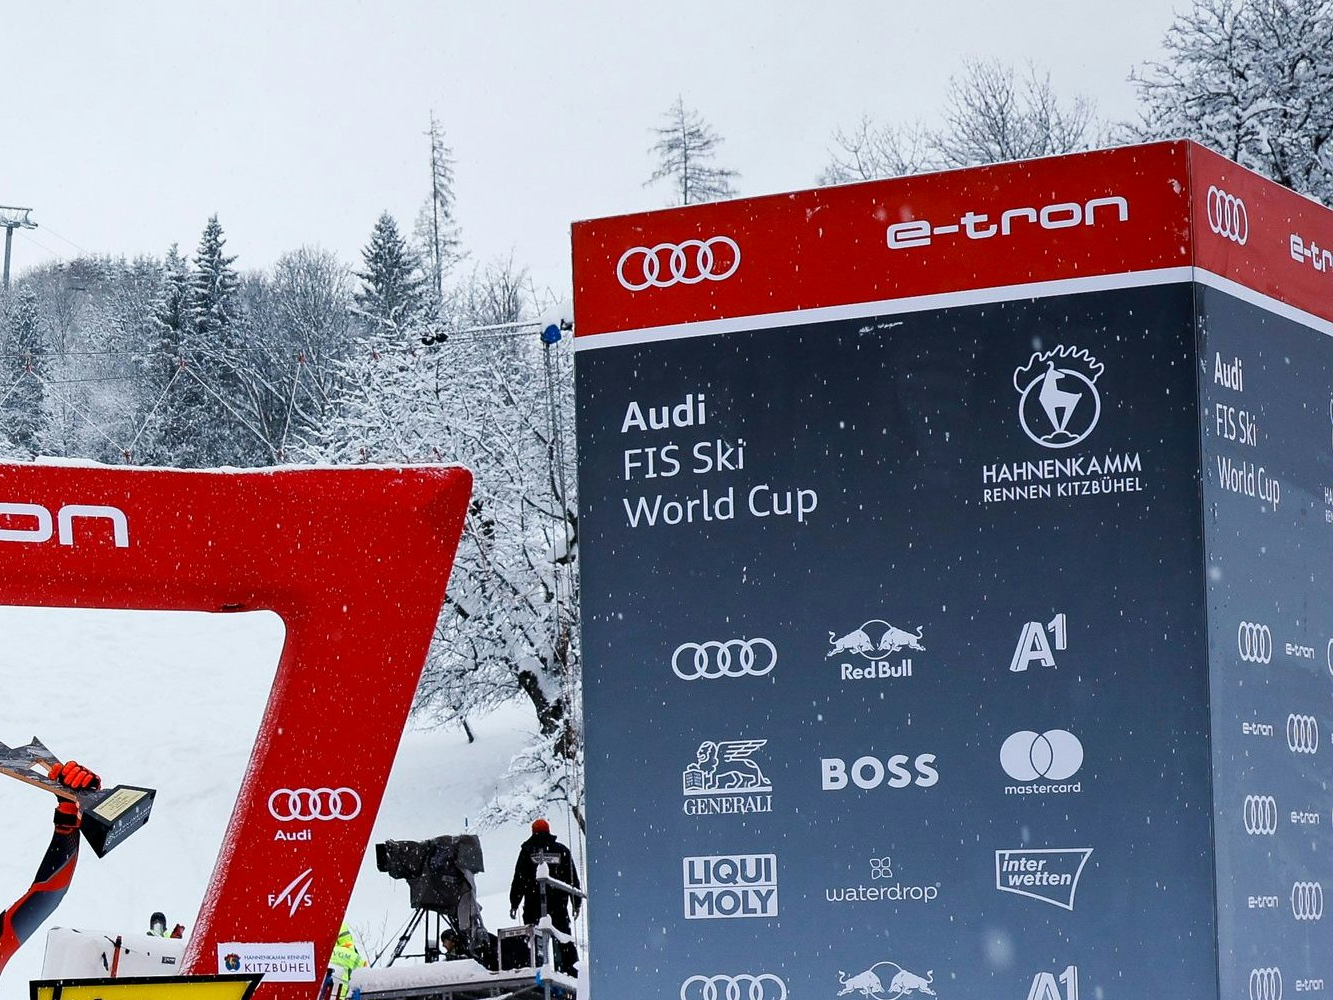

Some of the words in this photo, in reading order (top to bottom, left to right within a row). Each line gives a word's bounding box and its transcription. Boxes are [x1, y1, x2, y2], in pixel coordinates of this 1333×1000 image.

[887, 195, 1129, 250] e-tron
[1290, 233, 1333, 273] e-tr
[1214, 352, 1244, 392] Audi
[622, 394, 706, 433] Audi
[1217, 403, 1236, 441] FIS
[1239, 410, 1256, 448] Ski
[625, 442, 681, 480] FIS
[694, 438, 746, 474] Ski
[983, 452, 1142, 483] HAHNENKAMM
[984, 484, 1051, 502] RENNEN
[1057, 476, 1142, 497] KITZBÜHEL
[1218, 456, 1255, 498] World
[1258, 467, 1280, 511] Cup
[623, 482, 734, 528] World
[747, 481, 818, 522] Cup
[1010, 613, 1067, 673] A1
[1285, 642, 1315, 659] e-tron
[1243, 722, 1273, 737] e-tron
[822, 754, 939, 790] BOSS
[1005, 781, 1081, 795] mastercard
[683, 796, 773, 816] GENERALI
[1291, 810, 1319, 824] e-tron
[274, 829, 312, 841] Audi
[689, 856, 772, 885] LIQUI
[1002, 851, 1048, 872] inter
[1008, 868, 1072, 888] wetten
[689, 889, 775, 917] MOLY
[826, 881, 939, 904] waterdrop
[1248, 896, 1278, 908] e-tron
[244, 961, 311, 973] KITZBÜHEL
[1296, 978, 1324, 991] e-tron
